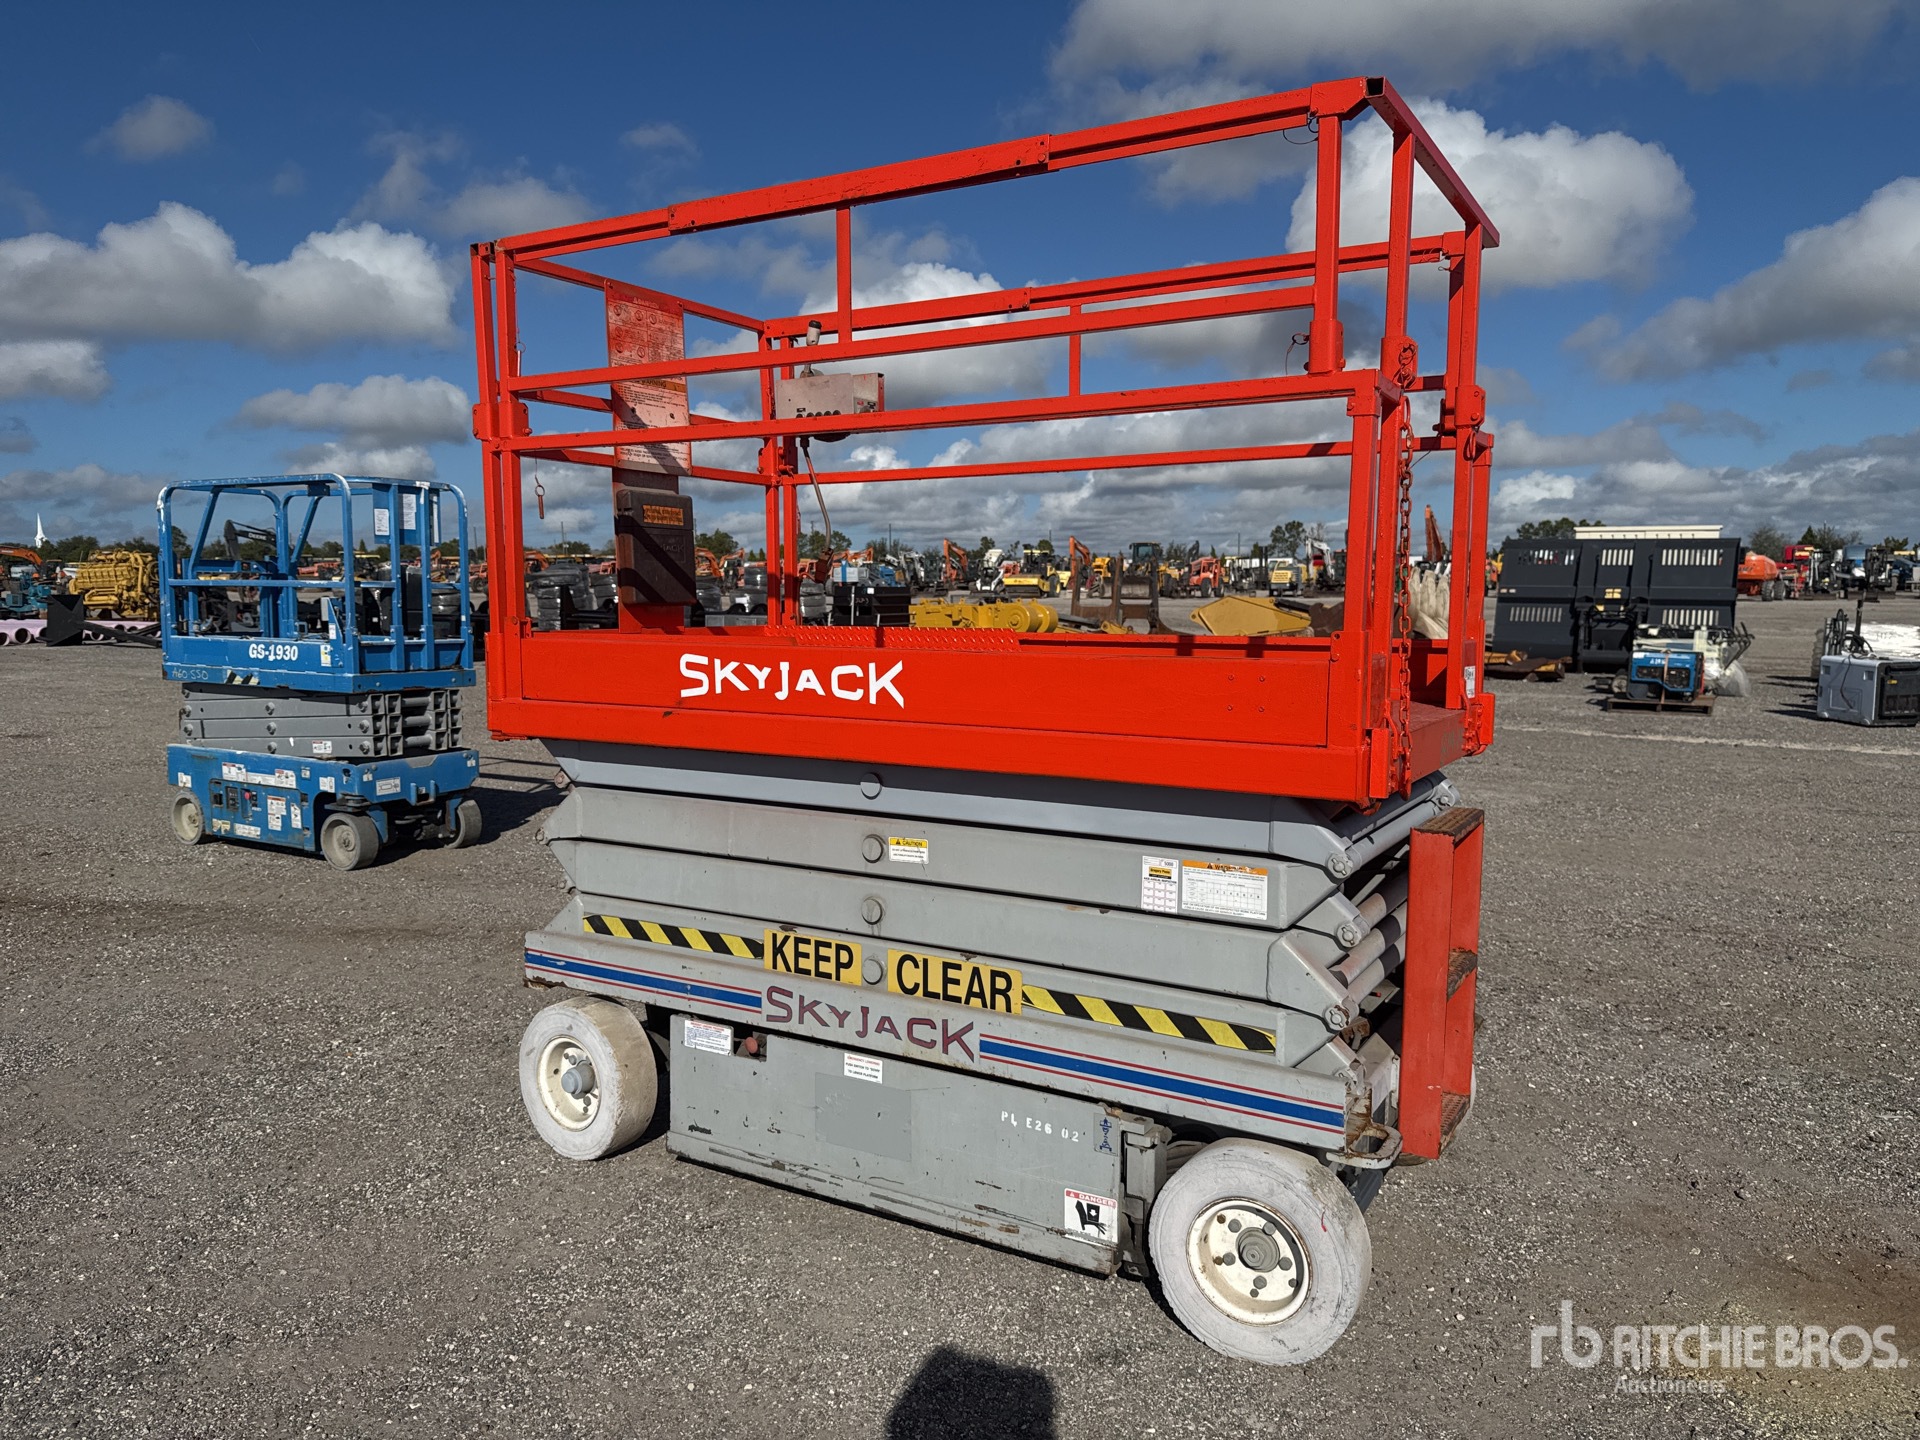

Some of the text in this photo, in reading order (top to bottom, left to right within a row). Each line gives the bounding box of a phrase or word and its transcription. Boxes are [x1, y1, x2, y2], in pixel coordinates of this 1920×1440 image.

[248, 532, 267, 540] DEERE
[248, 643, 298, 661] GS-1930
[679, 653, 905, 709] SKYJACK
[771, 933, 1012, 1013] KEEP CLEAR
[766, 986, 975, 1063] SKYJACK
[1026, 1117, 1052, 1134] E26
[1079, 1194, 1116, 1208] DANGER
